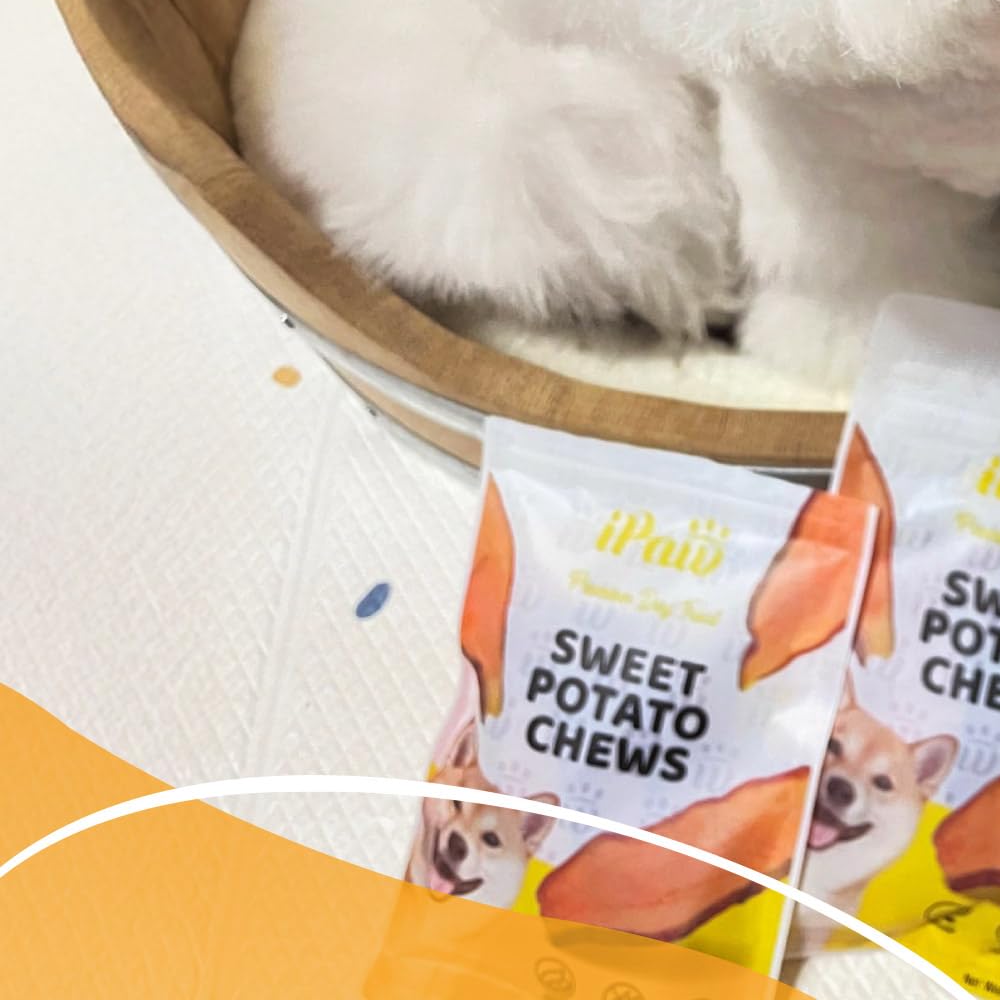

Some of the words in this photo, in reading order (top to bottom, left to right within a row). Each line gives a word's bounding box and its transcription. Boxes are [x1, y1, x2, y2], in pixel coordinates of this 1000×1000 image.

[595, 510, 730, 577] iPaw
[549, 628, 708, 698] SWEET
[526, 666, 711, 742] POTATO
[525, 714, 691, 783] CHEWS
